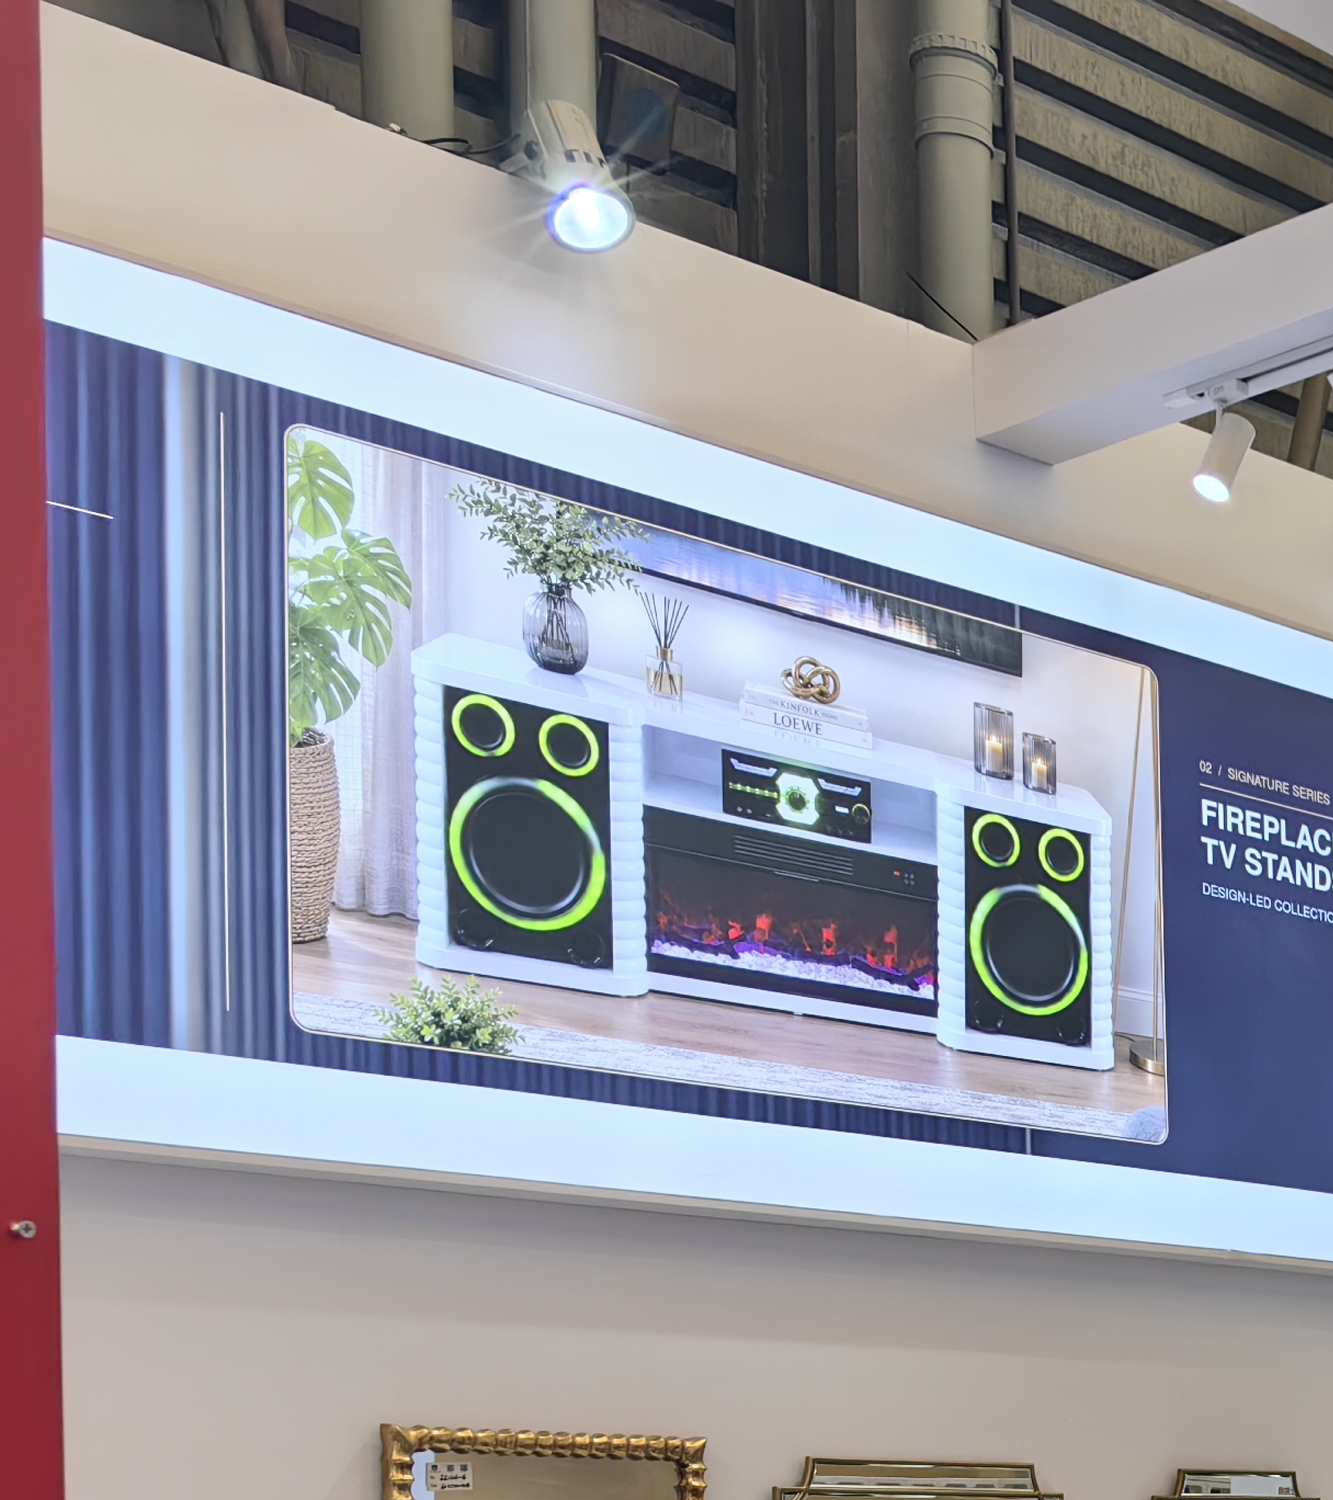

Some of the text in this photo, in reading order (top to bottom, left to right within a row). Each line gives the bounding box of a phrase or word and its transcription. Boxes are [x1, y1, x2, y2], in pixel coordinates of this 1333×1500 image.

[780, 700, 820, 717] KINFOLK
[773, 712, 823, 736] LOEWE
[1199, 760, 1213, 775] 02
[1227, 767, 1290, 795] SIGNATURE
[1292, 785, 1331, 806] SERIES
[1200, 836, 1237, 870] TV
[1202, 882, 1272, 911] DESIGN-LED
